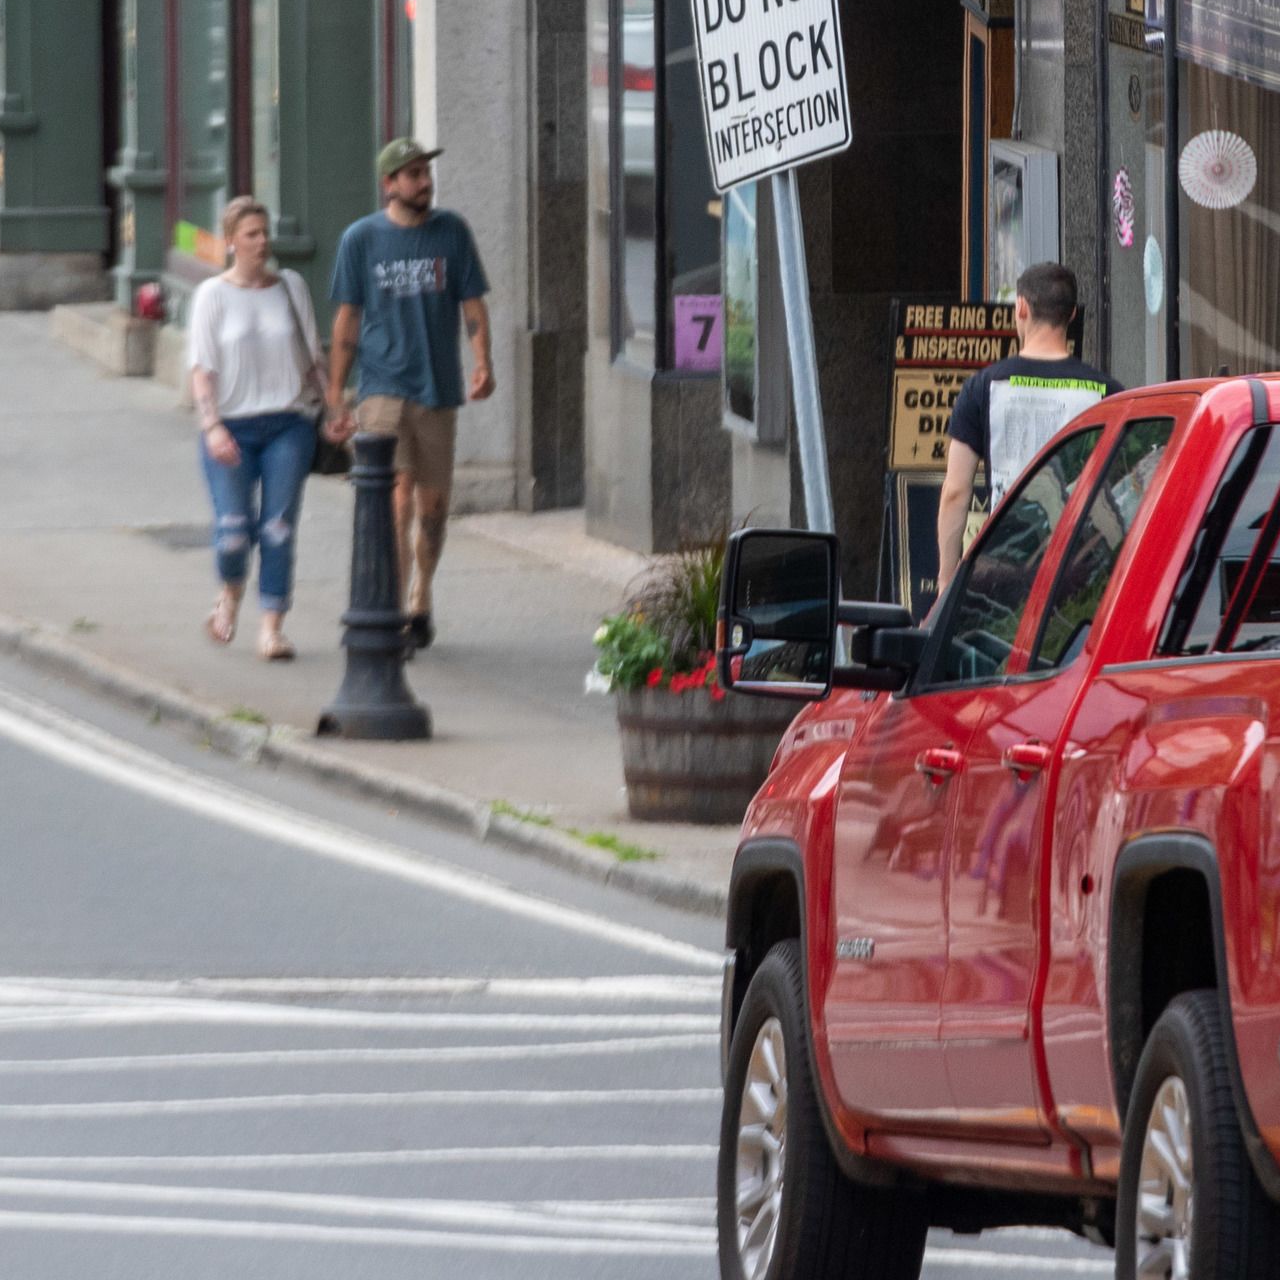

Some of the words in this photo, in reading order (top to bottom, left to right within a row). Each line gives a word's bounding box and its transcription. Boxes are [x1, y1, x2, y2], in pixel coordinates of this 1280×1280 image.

[707, 19, 833, 112] BLOCK
[715, 87, 840, 164] INTERSECTION
[691, 315, 716, 352] 7
[906, 305, 944, 330] FREE
[949, 306, 986, 330] RING
[895, 337, 906, 359] &
[912, 335, 1001, 360] INSPECTION
